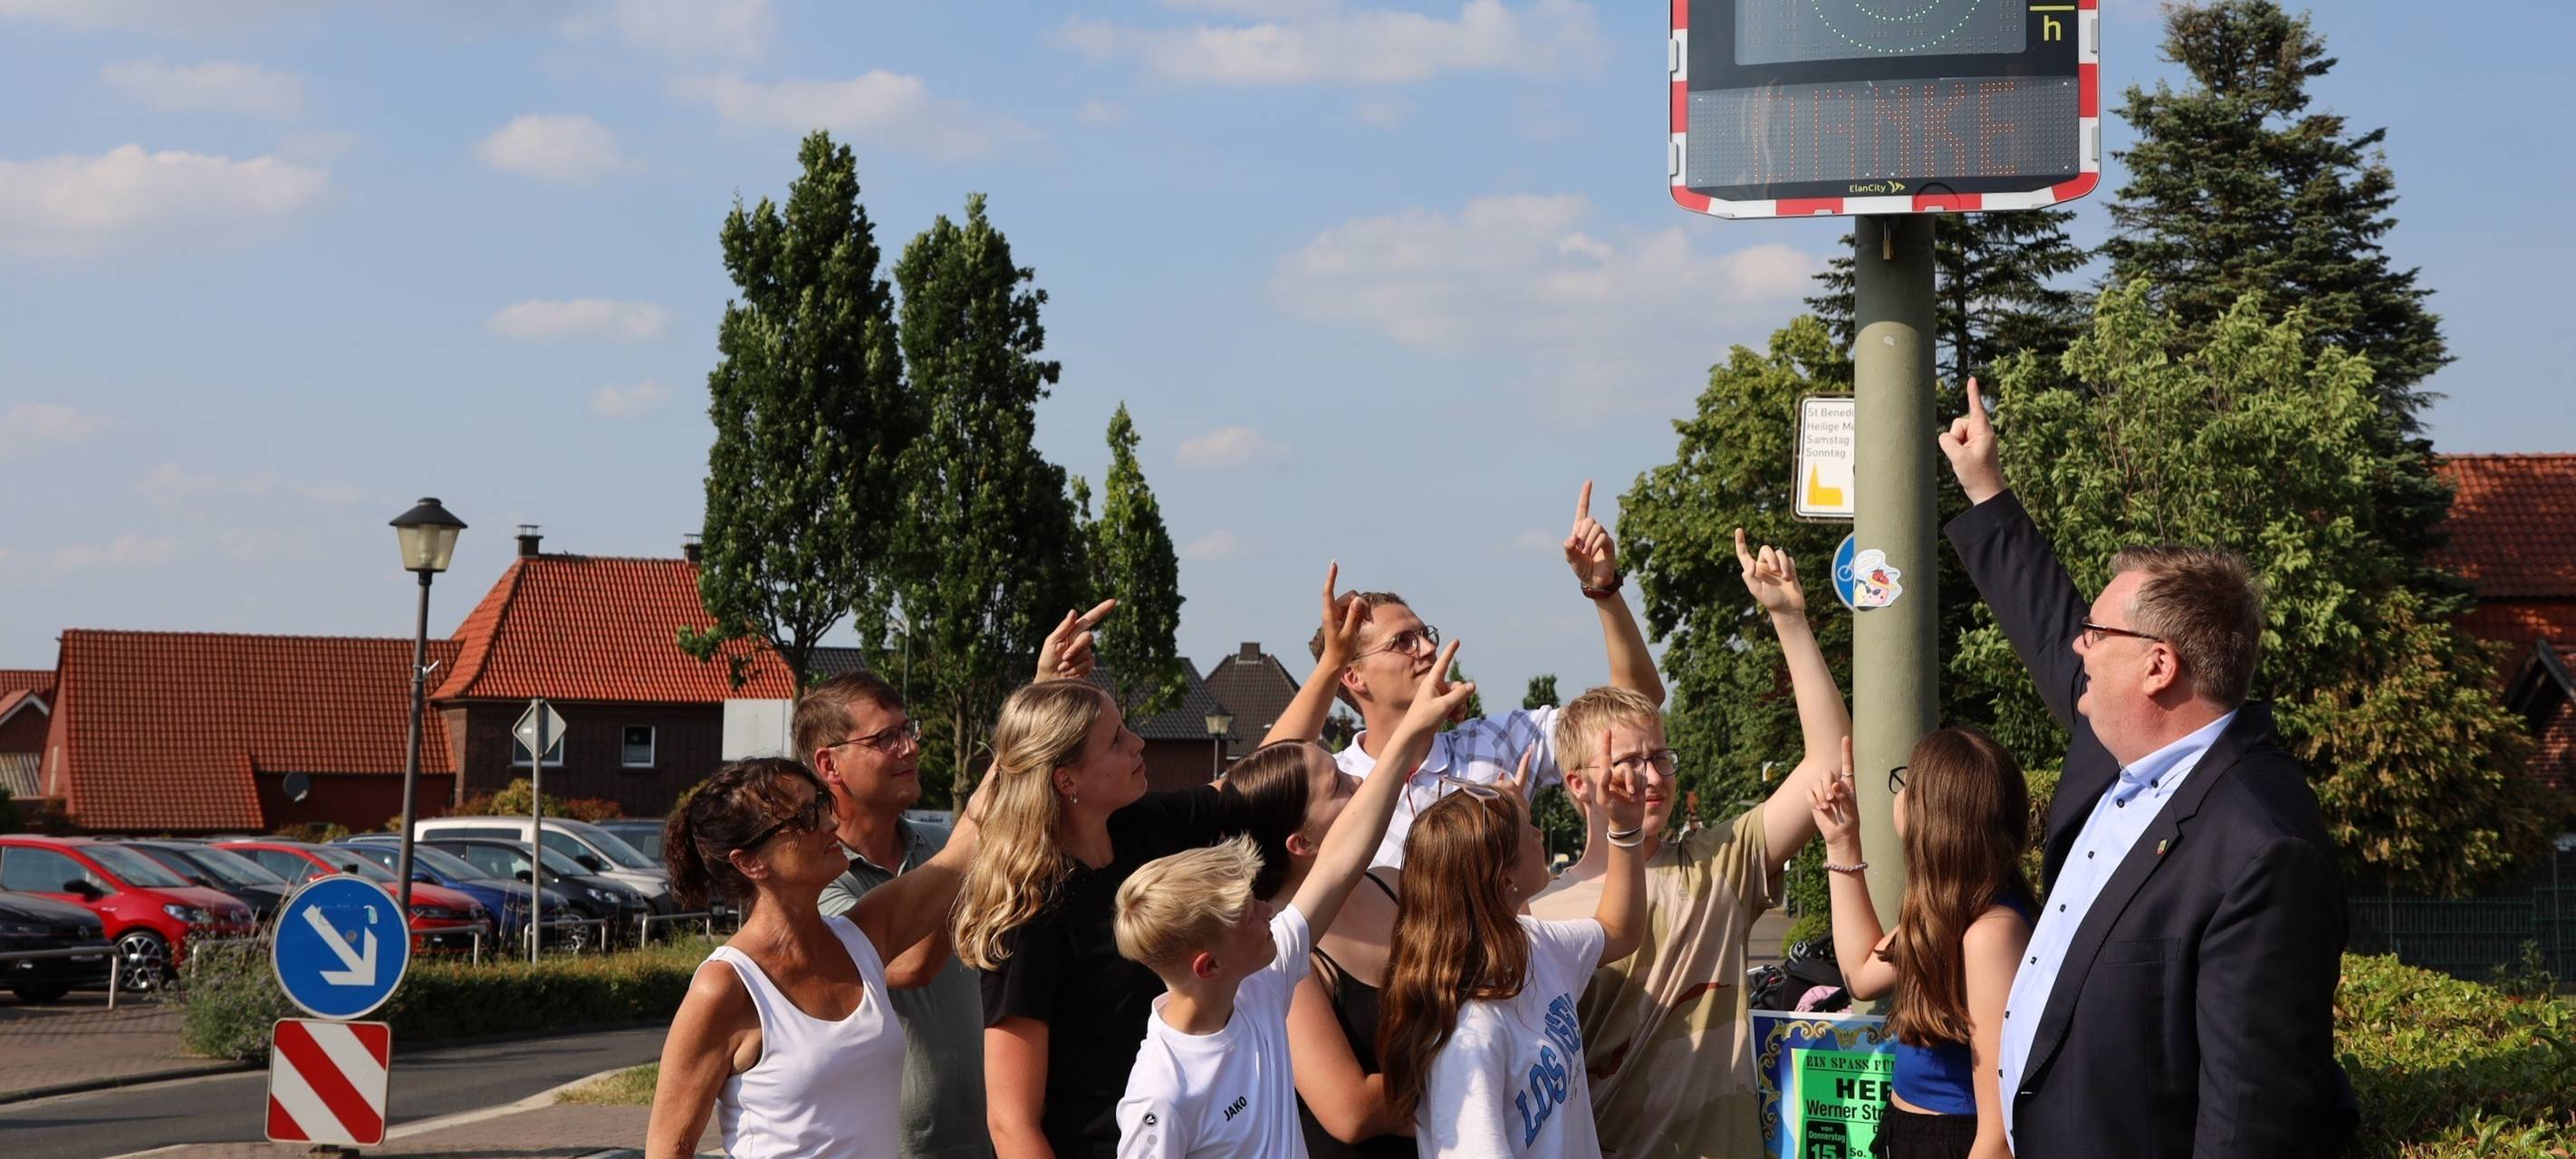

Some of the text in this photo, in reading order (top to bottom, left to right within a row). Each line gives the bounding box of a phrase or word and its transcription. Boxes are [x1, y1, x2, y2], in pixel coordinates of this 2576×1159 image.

[2043, 14, 2062, 42] h
[1754, 81, 2016, 182] DANKE
[1849, 184, 1886, 194] ElanCity
[1807, 422, 1840, 433] Heilige
[1806, 435, 1850, 446] Samstag
[1806, 447, 1846, 459] Sonntag
[1806, 1056, 1826, 1068] EIN
[1831, 1057, 1870, 1070] SPASS
[1515, 1044, 1567, 1150] LOS
[1224, 1096, 1247, 1122] JAKO
[1806, 1099, 1858, 1119] Werner
[1808, 1131, 1845, 1143] Donnerstag
[1850, 1147, 1866, 1158] So.
